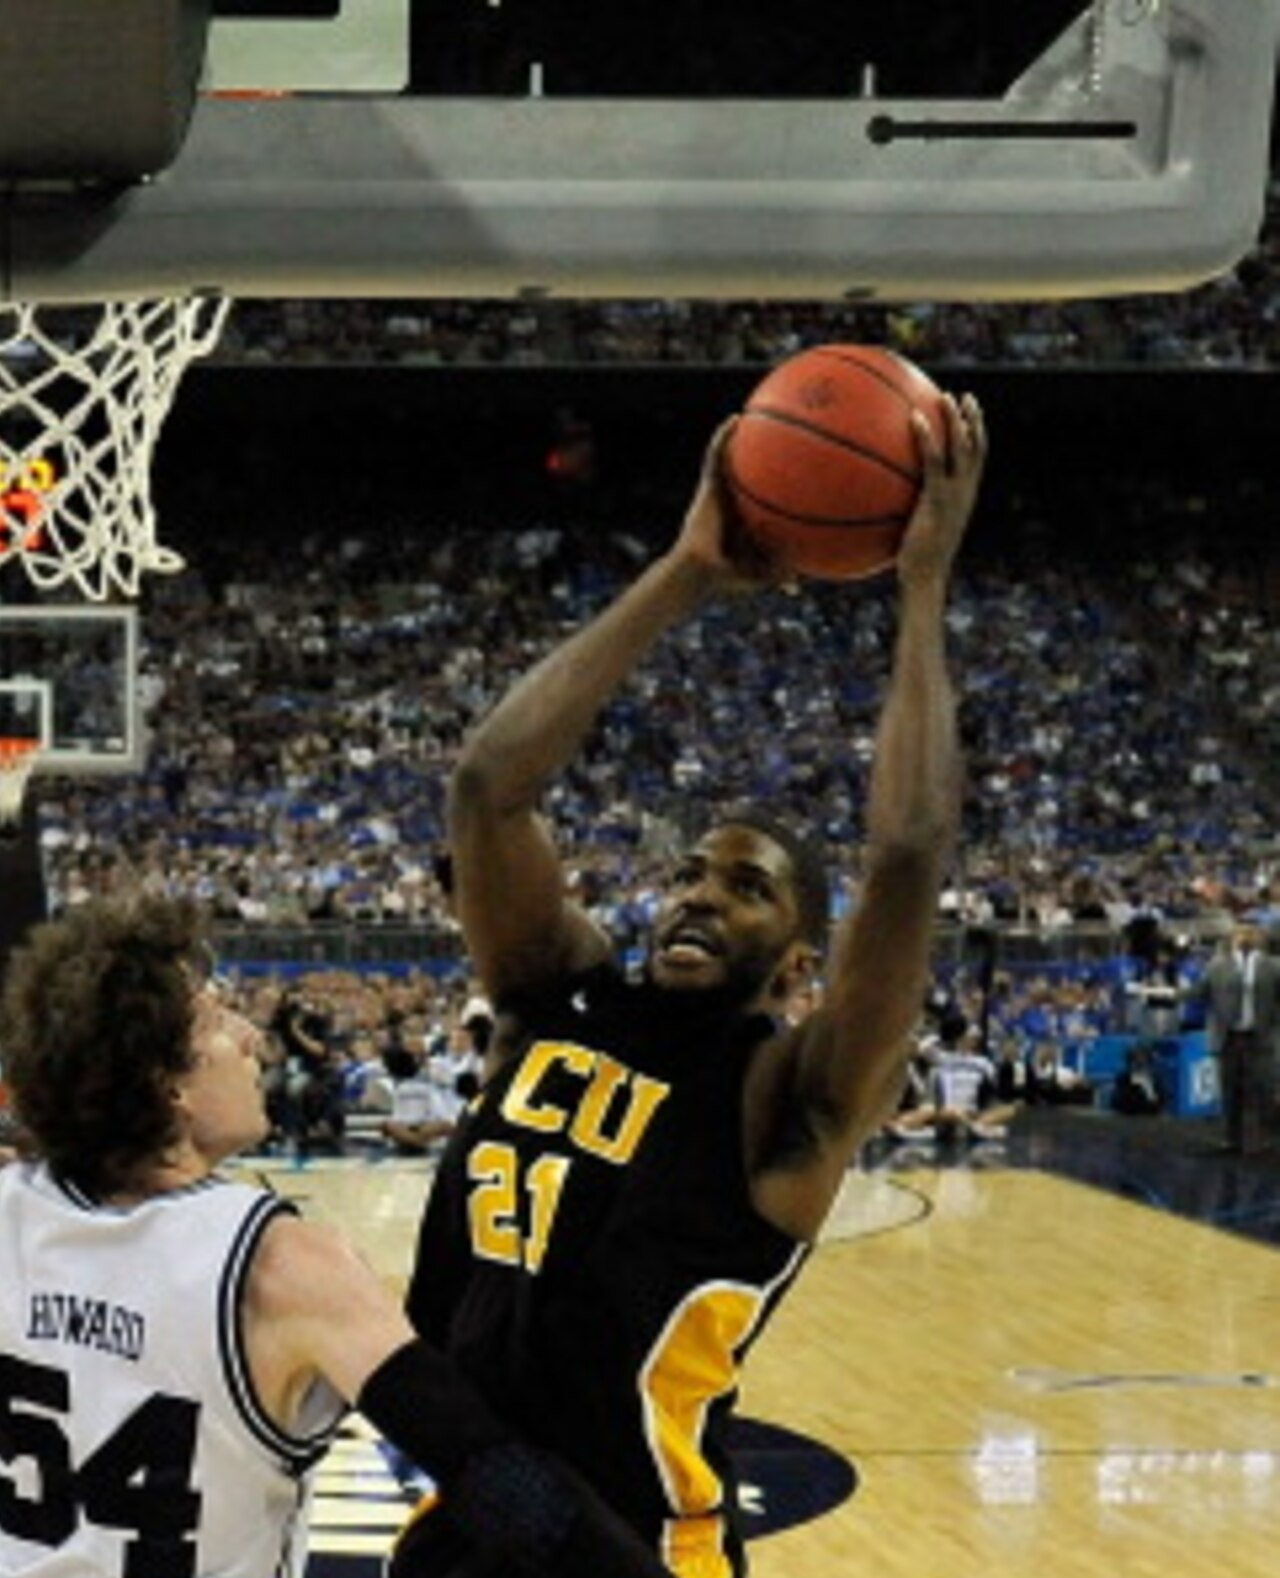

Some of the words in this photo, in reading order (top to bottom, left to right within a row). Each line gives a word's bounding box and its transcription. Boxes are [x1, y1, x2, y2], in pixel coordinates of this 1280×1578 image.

[467, 1040, 671, 1165] CU
[467, 1141, 571, 1275] 21
[26, 1293, 145, 1361] HOWARD
